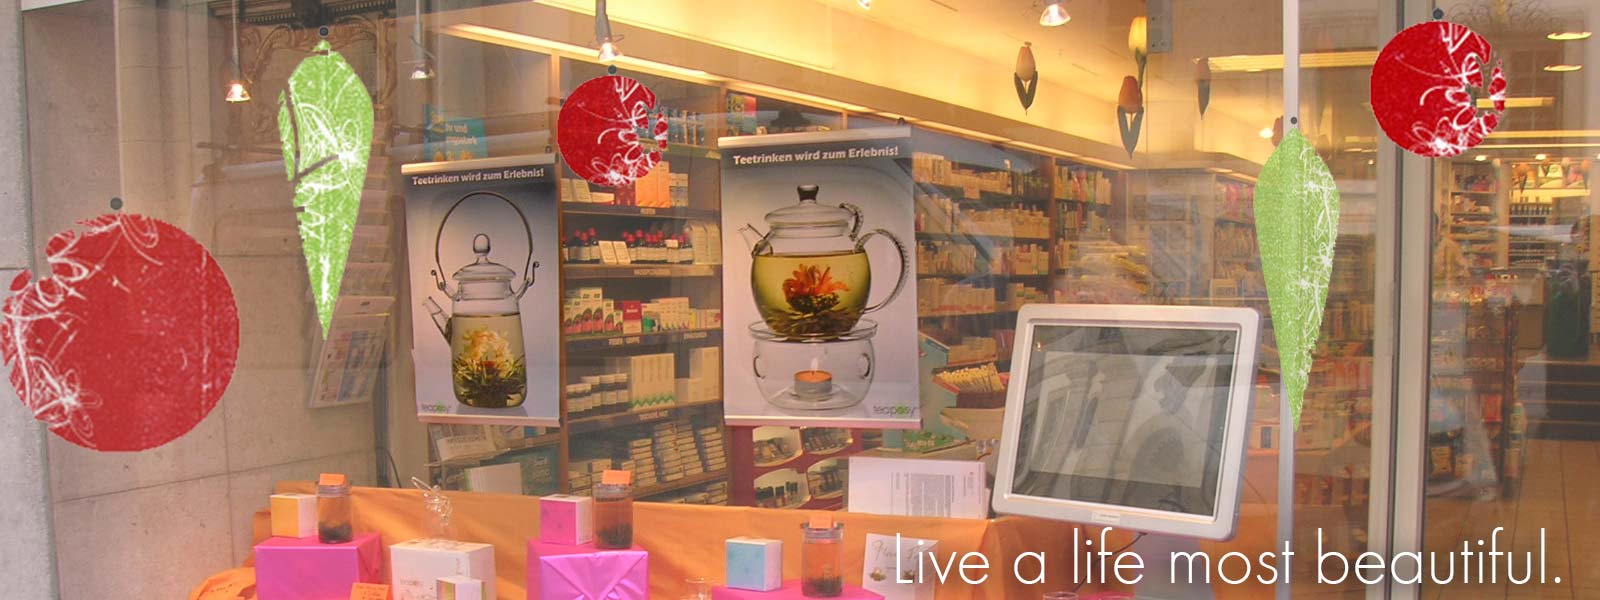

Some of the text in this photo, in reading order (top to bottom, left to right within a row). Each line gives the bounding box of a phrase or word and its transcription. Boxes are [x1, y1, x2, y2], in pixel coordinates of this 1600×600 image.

[734, 146, 899, 165] Teetrinken wird zum Erlebnis!
[411, 168, 544, 186] Teetrinken wird zum Erlebnis!
